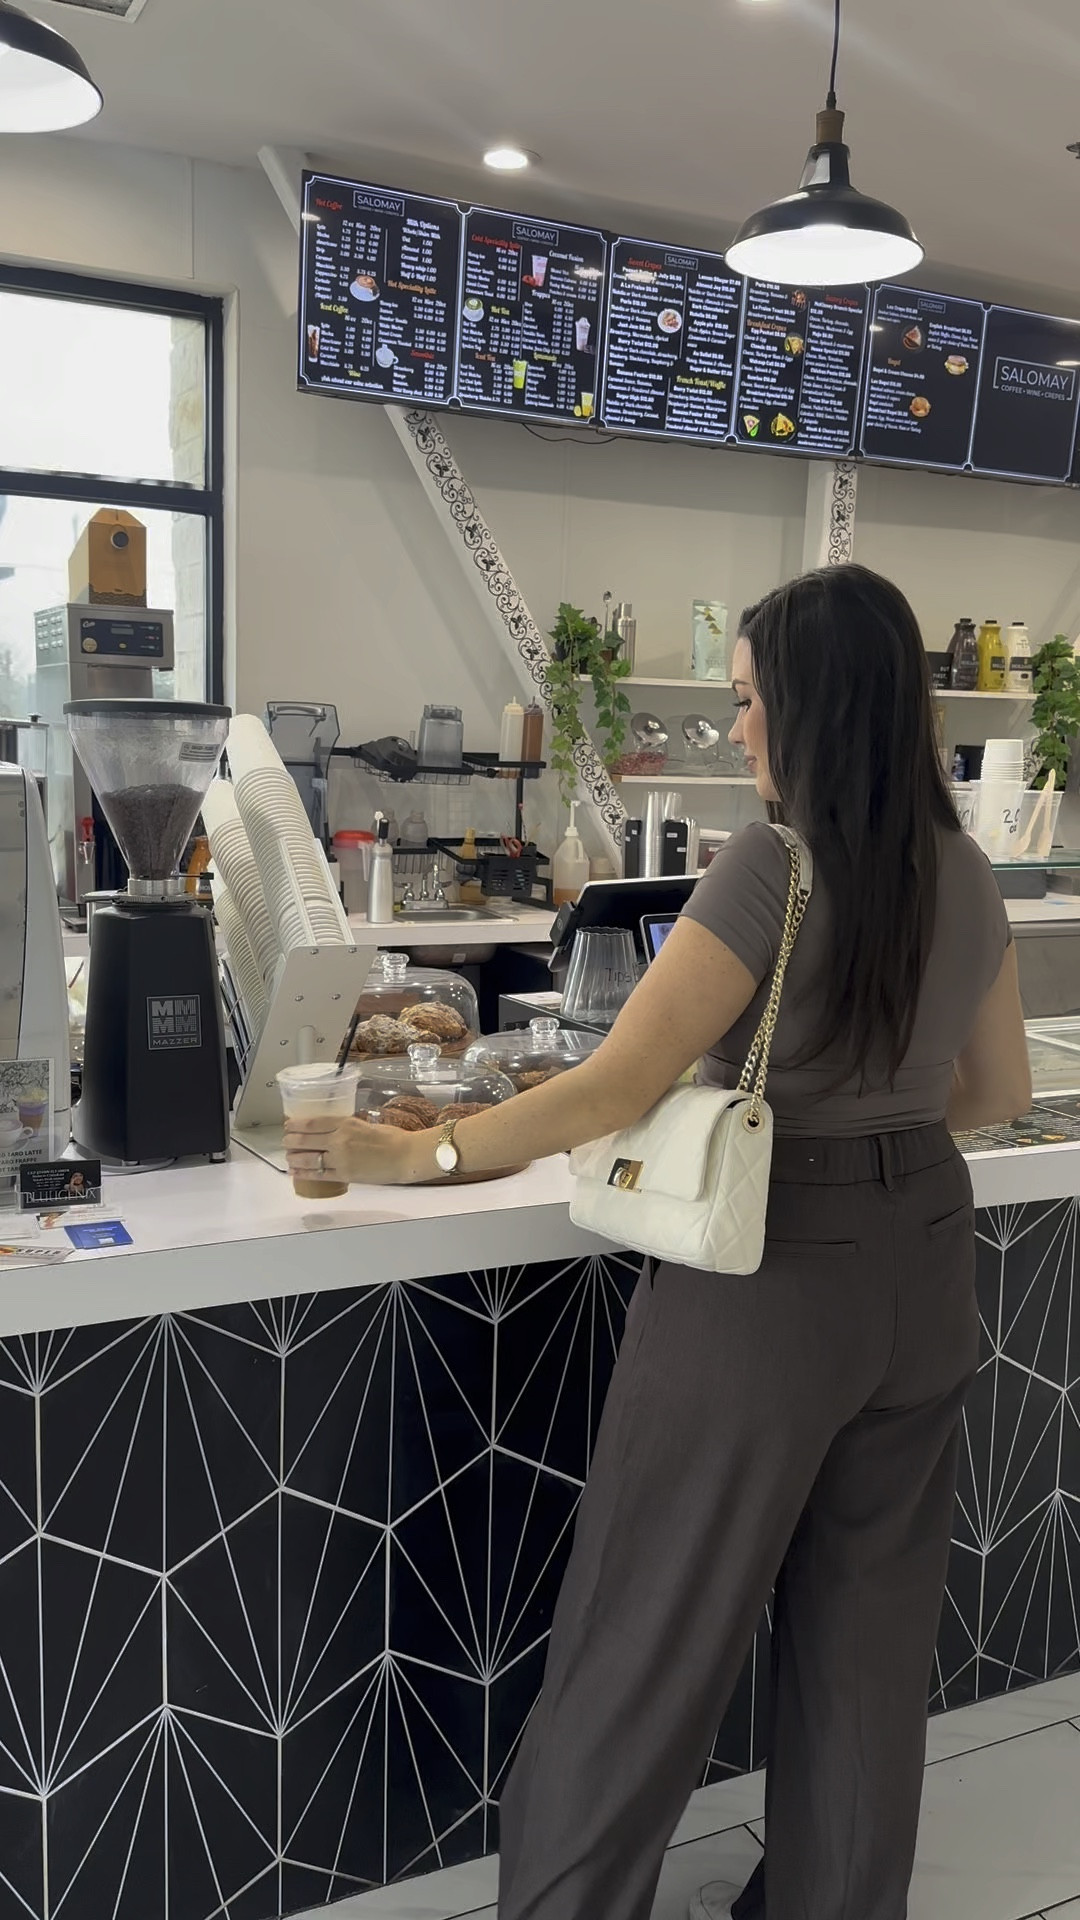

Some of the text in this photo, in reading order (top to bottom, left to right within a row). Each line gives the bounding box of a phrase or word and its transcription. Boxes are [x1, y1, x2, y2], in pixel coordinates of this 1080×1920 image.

[357, 195, 400, 211] SALOMAY
[515, 226, 554, 241] SALOMAY
[667, 257, 694, 266] SALOMAY
[1001, 366, 1068, 390] SALOMAY
[1001, 384, 1064, 400] COFFEE WINE CREPES
[152, 1038, 198, 1046] MAZZER
